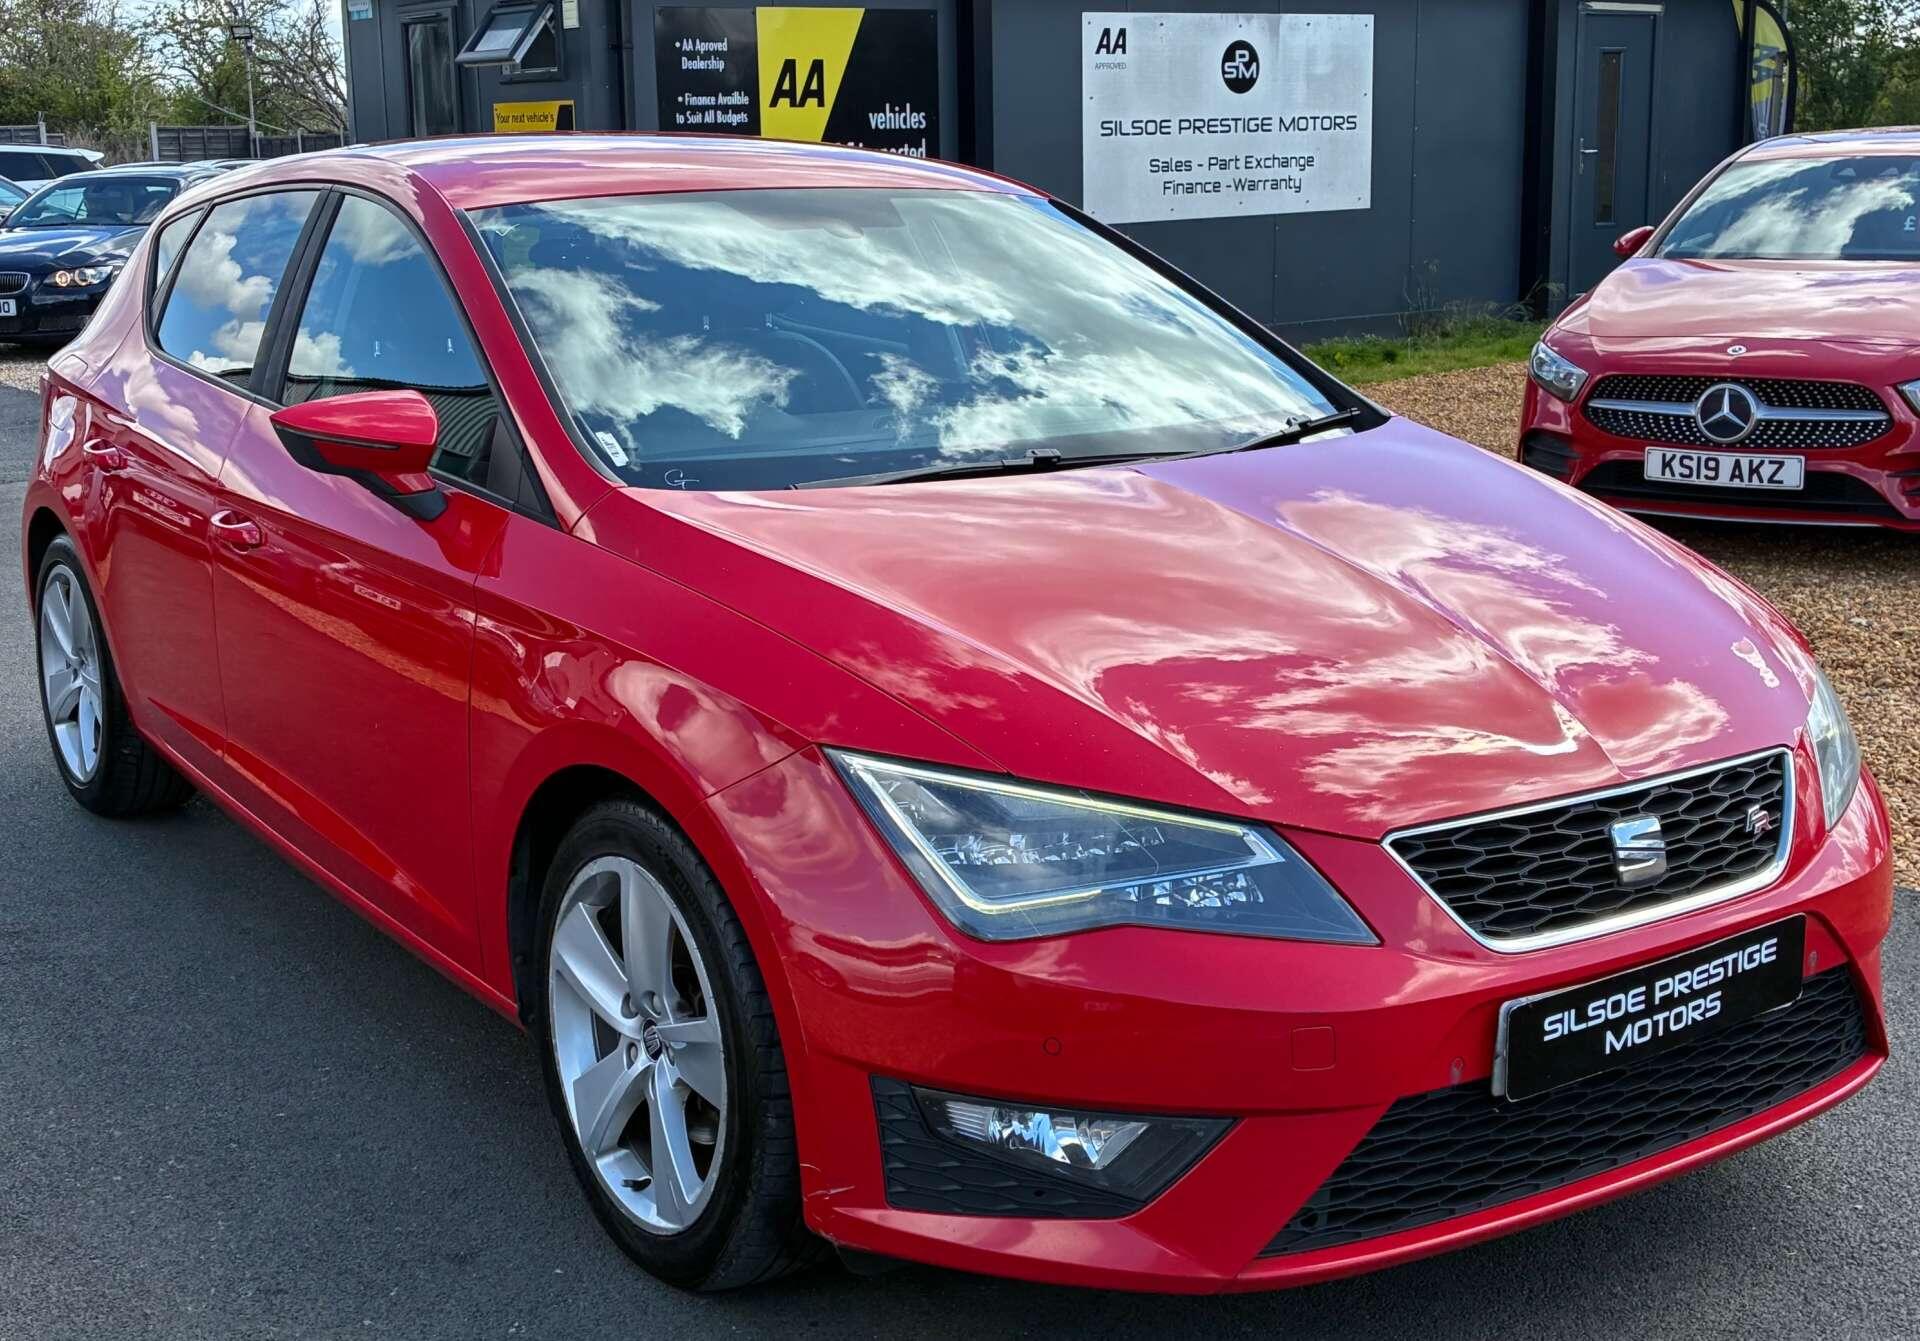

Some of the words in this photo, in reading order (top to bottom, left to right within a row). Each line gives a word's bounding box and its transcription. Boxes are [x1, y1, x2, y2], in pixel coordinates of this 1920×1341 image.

[682, 38, 693, 51] AA
[695, 37, 728, 54] Aproved
[1095, 28, 1127, 55] AA
[681, 55, 725, 72] Dealership
[1095, 62, 1127, 70] APPROVED
[768, 59, 825, 108] AA
[684, 92, 716, 106] Finance
[496, 112, 510, 124] Your
[511, 113, 525, 123] next
[676, 112, 684, 124] to
[686, 110, 702, 124] Suit
[704, 109, 715, 123] All
[716, 109, 748, 126] Budgets
[868, 103, 926, 130] vehicles
[1100, 119, 1172, 137] SILSOE
[1178, 116, 1273, 135] PRESTIGE
[1279, 115, 1358, 132] MOTORS
[1149, 158, 1193, 173] Sales
[1208, 155, 1240, 171] Part
[1244, 154, 1315, 172] Exchange
[1163, 180, 1221, 195] Finance
[1661, 453, 1720, 481] KS19
[1729, 459, 1784, 484] AKZ
[1543, 985, 1646, 1042] SILSOE
[1654, 937, 1778, 1005] PRESTIGE
[1605, 990, 1722, 1055] MOTORS
